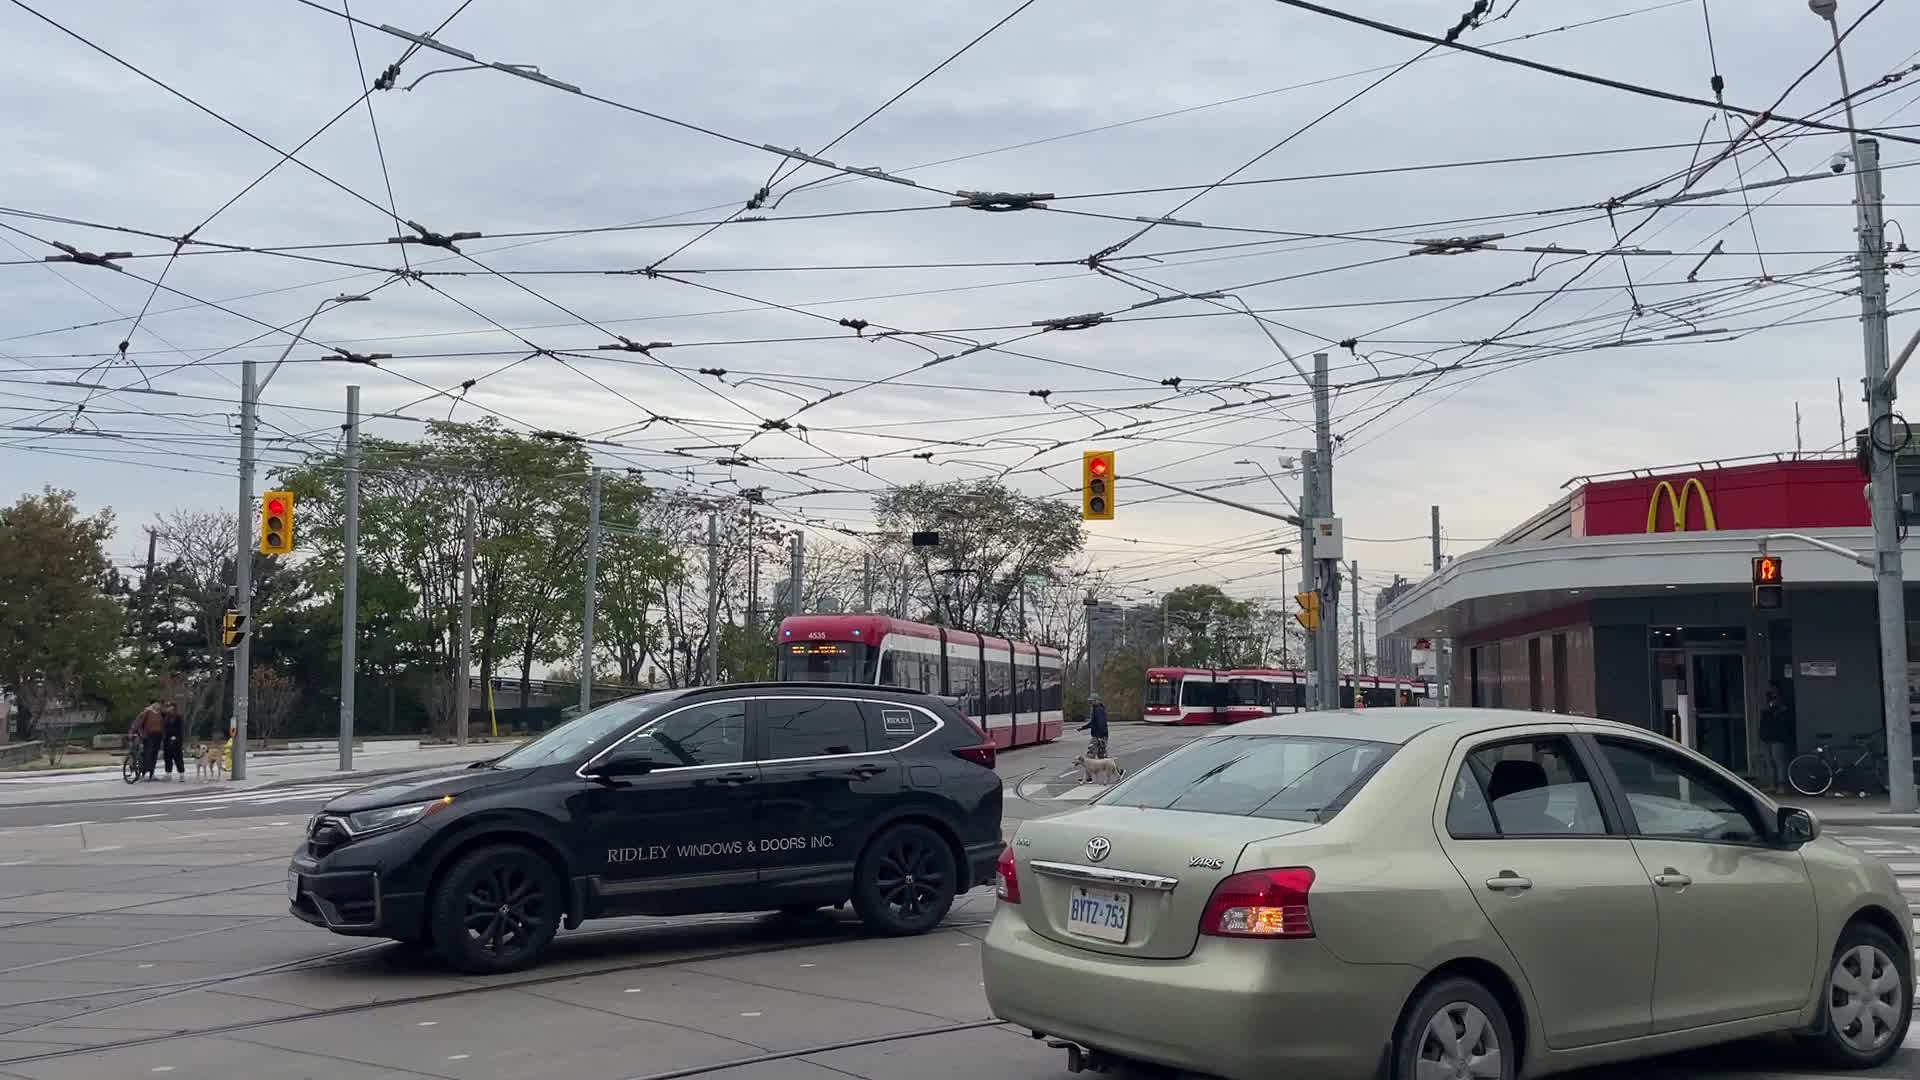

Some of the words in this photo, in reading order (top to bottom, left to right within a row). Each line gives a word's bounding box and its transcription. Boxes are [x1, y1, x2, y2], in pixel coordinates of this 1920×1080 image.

[808, 632, 826, 640] 4535
[607, 845, 670, 863] RIDLEY
[677, 841, 743, 857] WINDOWS
[747, 840, 756, 853] &
[760, 837, 806, 852] DOORS
[811, 835, 834, 849] INC.
[1189, 856, 1224, 869] YARIS
